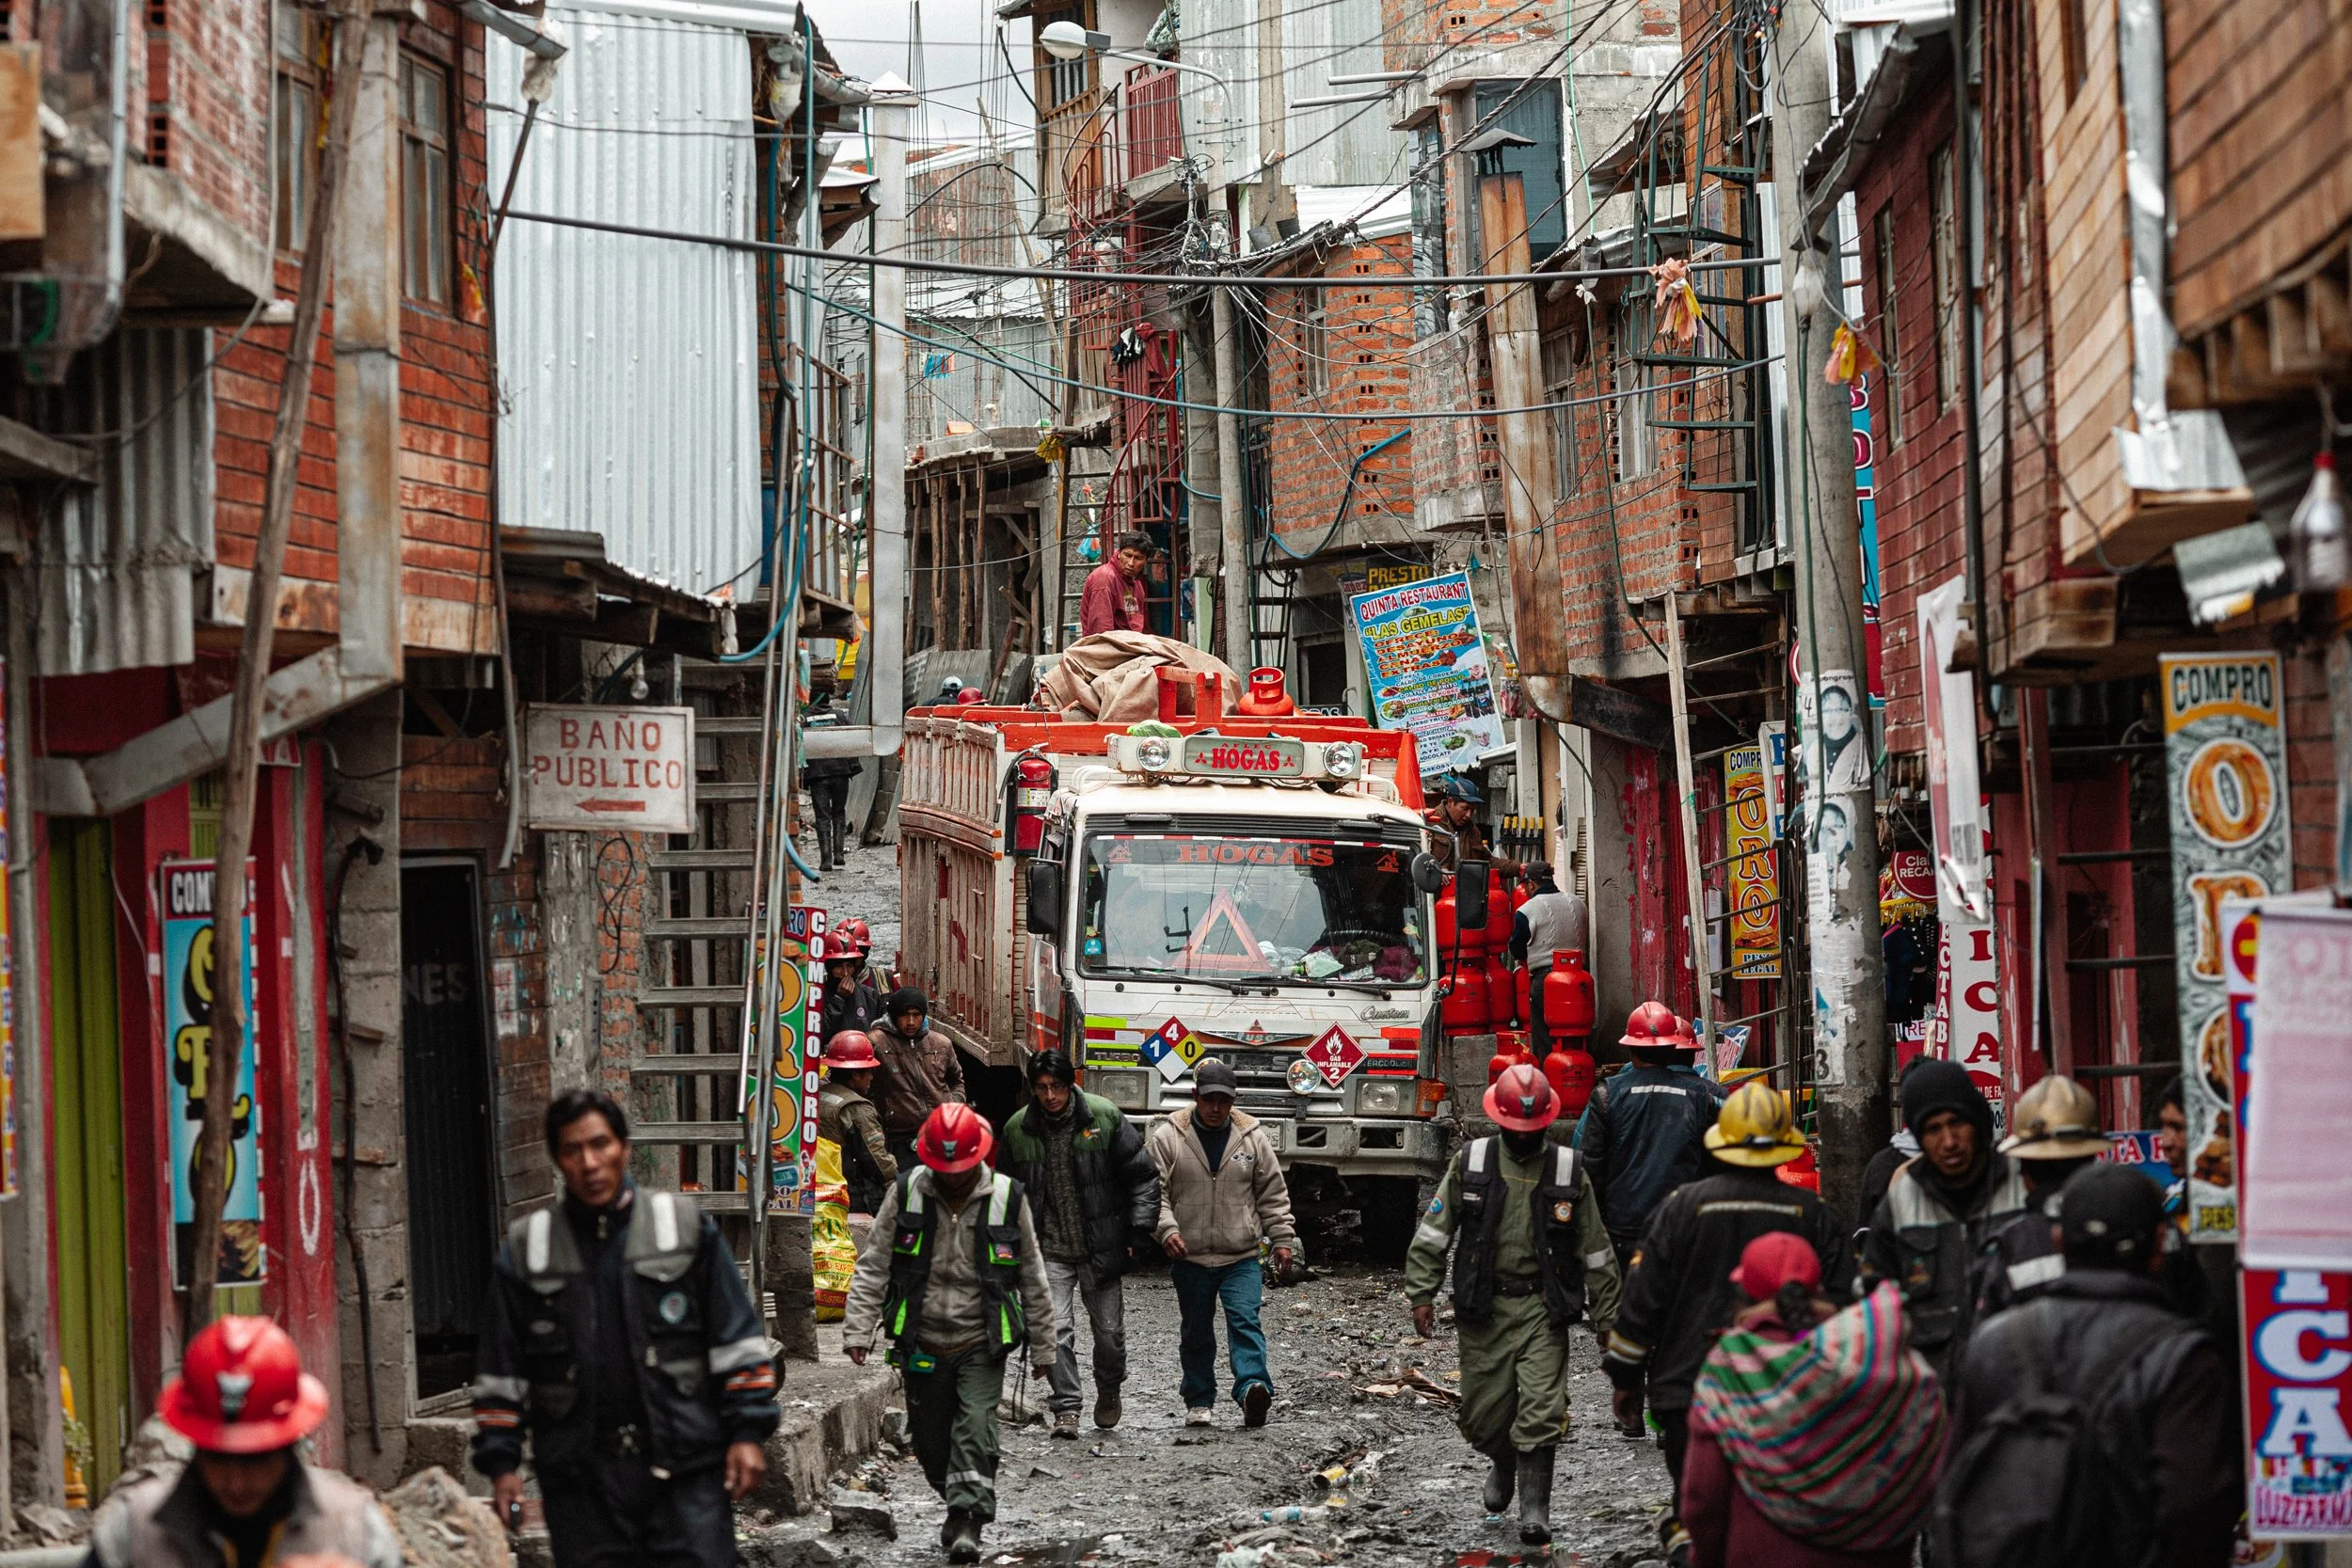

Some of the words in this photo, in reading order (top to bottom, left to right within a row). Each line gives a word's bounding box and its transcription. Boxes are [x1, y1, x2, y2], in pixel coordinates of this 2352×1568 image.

[1369, 565, 1429, 583] PRESTO
[1360, 596, 1399, 621] QUINTA
[1399, 582, 1468, 606] RESTAURANT
[1376, 633, 1459, 656] DESAYUNO
[1377, 641, 1461, 663] ALMUERZO
[1379, 657, 1420, 671] CENA
[1381, 660, 1441, 678] EXTRAS
[1398, 682, 1424, 692] CALDO
[1438, 674, 1465, 685] POLLO
[1428, 670, 1459, 680] CORDERO
[2171, 660, 2272, 716] COMPRO
[560, 714, 661, 752] BAÑO
[1221, 741, 1272, 750] AFLEC
[1211, 748, 1280, 771] HOGAS
[1729, 751, 1762, 771] COMPR
[532, 751, 682, 790] PÚBLICO
[1177, 844, 1335, 867] HOGAS
[1735, 786, 1775, 931] ORO
[1905, 855, 1929, 867] Cla
[805, 910, 826, 1059] COMPRO
[1360, 1005, 1411, 1022] Custom
[1165, 1022, 1179, 1041] 4
[1094, 1052, 1141, 1062] TURBO
[1150, 1039, 1160, 1057] 1
[1184, 1041, 1196, 1058] 0
[1329, 1068, 1340, 1079] 2
[1985, 1086, 1994, 1098] DE
[802, 1070, 819, 1145] ORO
[2200, 1205, 2235, 1231] PES
